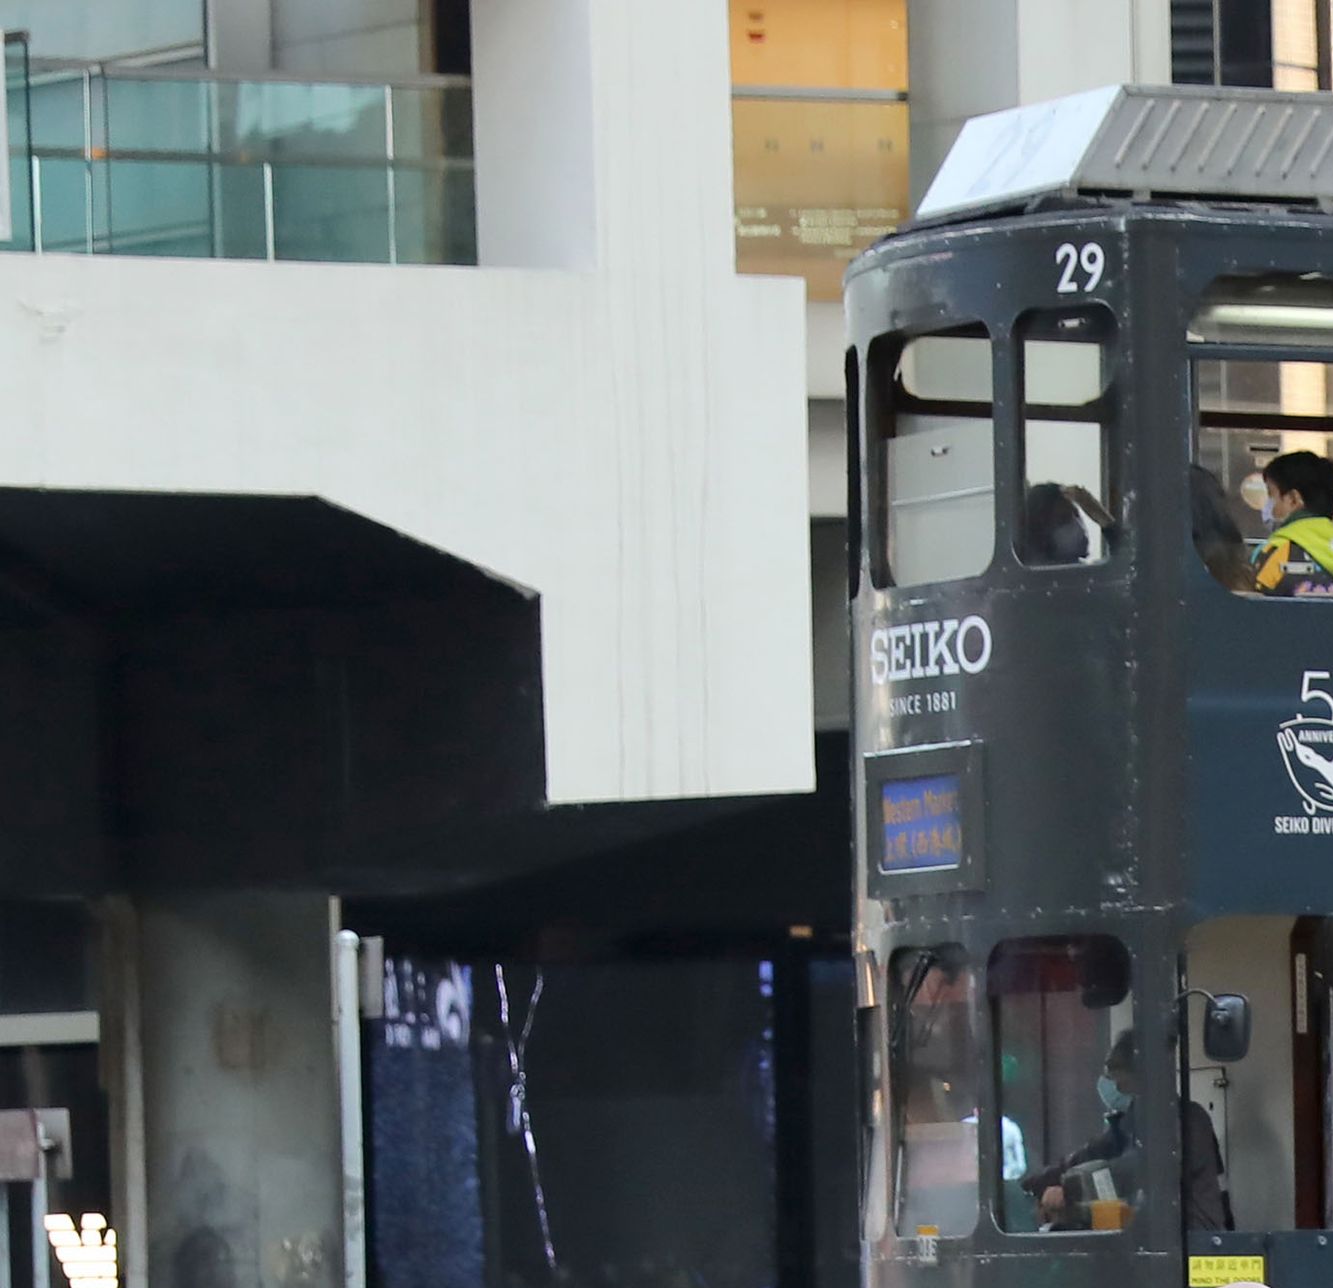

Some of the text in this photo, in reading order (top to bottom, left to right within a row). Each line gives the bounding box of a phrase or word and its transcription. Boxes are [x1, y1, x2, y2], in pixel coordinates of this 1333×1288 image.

[1056, 242, 1104, 293] 29
[871, 614, 992, 685] SEIKO
[889, 691, 956, 717] SINCE 1881
[1274, 816, 1310, 834] SEIKO
